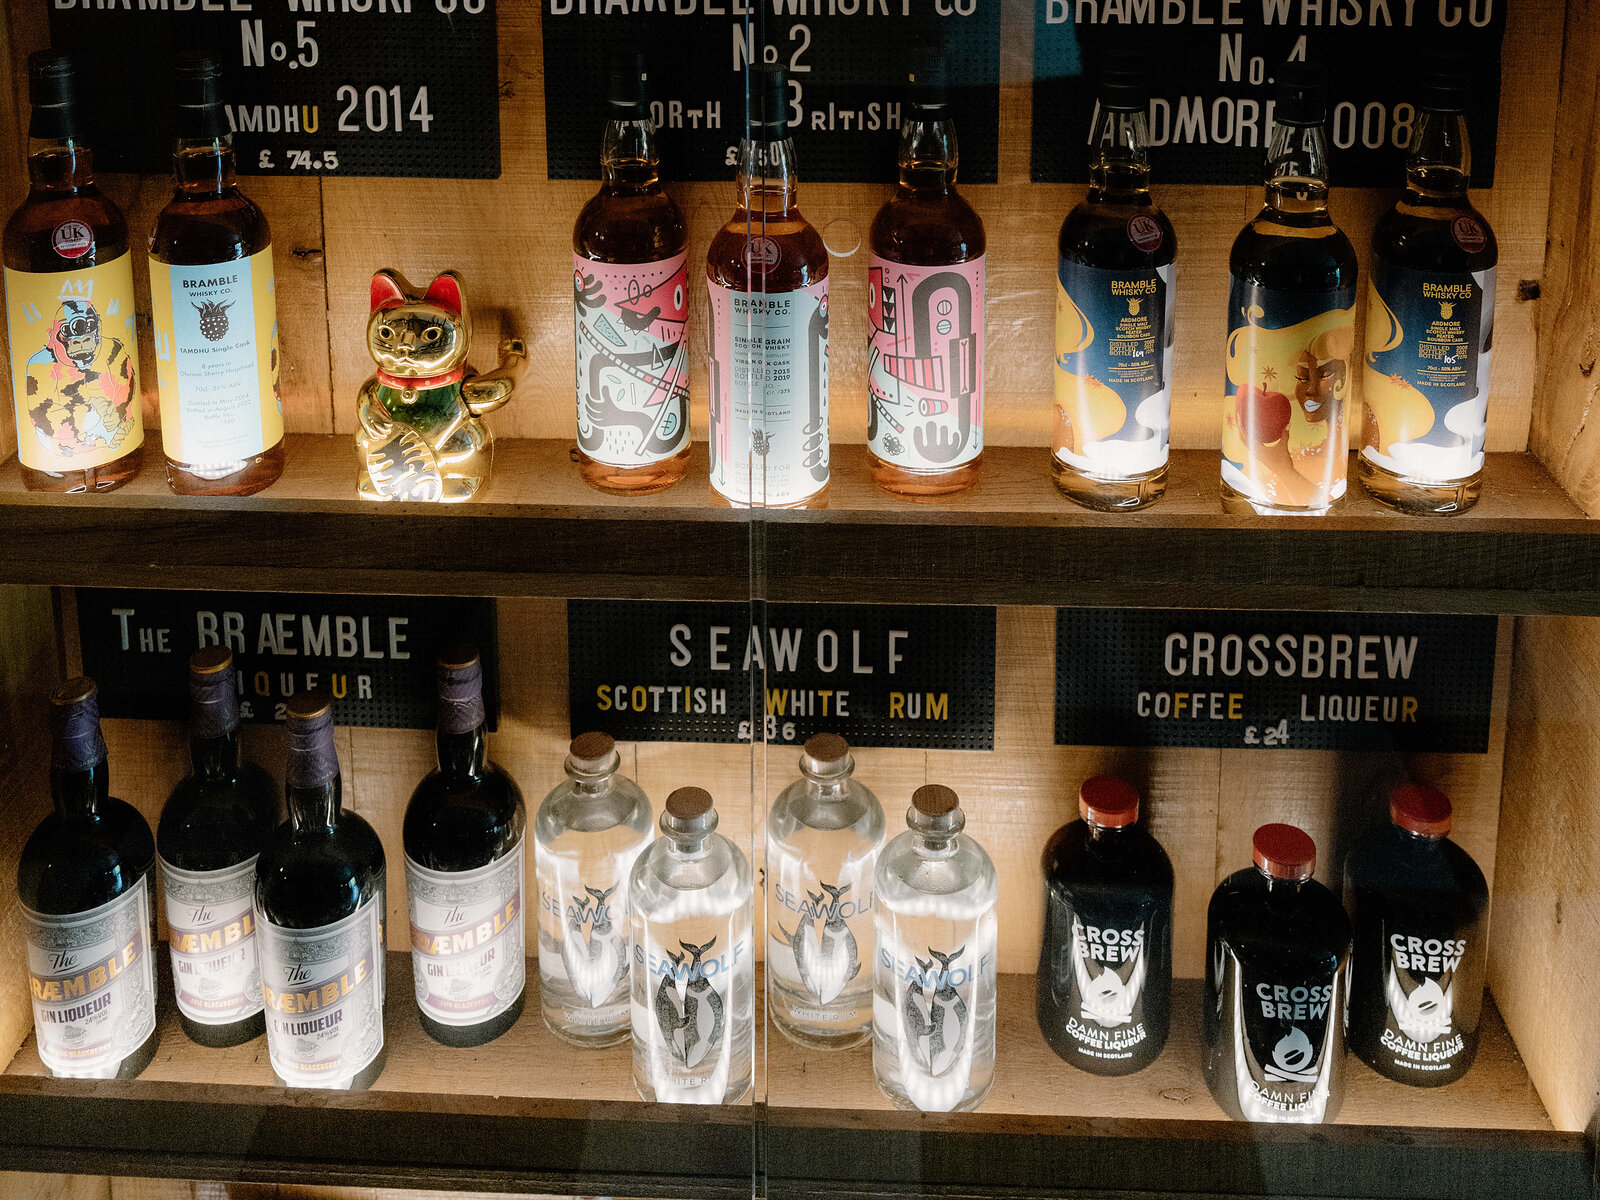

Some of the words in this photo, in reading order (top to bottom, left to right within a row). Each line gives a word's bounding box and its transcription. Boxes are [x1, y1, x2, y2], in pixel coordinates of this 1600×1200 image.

[337, 85, 434, 133] 2014
[61, 226, 84, 239] UK
[183, 274, 238, 290] BRAMBLE
[189, 288, 218, 297] WHISKY
[1111, 279, 1156, 290] BRAMBLE
[1111, 287, 1144, 296] WHISKY
[1145, 286, 1156, 294] CO
[1423, 282, 1472, 293] BRAMBLE
[1423, 290, 1458, 300] WHISKY
[1459, 290, 1472, 299] CO
[180, 347, 209, 355] TAMDHU
[211, 344, 233, 355] Single
[112, 608, 171, 653] THE
[670, 624, 908, 674] SEAWOLF
[1165, 632, 1418, 679] CROSSBREW
[597, 684, 726, 715] SCOTTISH
[766, 688, 849, 717] WHITE
[889, 691, 948, 720] RUM
[1137, 691, 1243, 720] COFFEE
[1301, 694, 1417, 723] LIQUEUR
[1071, 923, 1145, 946] CROSS
[1390, 933, 1467, 957] CROSS
[50, 950, 80, 972] The
[635, 941, 744, 981] SEAWOLF
[1078, 942, 1140, 963] BREW
[1394, 952, 1461, 973] BREW
[283, 964, 313, 983] The
[881, 947, 989, 988] SEAWOLF
[1256, 982, 1333, 1003] CROSS
[57, 992, 112, 1024] LIQUEUR
[1261, 1001, 1329, 1020] BREW
[290, 1009, 343, 1036] LIQUEUR
[1068, 1016, 1109, 1041] DAMN
[1114, 1022, 1145, 1041] FINE
[1065, 1024, 1103, 1049] COFFEE
[1104, 1030, 1147, 1050] LIQUEUR
[1383, 1028, 1428, 1052] DAMN
[1433, 1033, 1462, 1052] FINE
[1380, 1036, 1421, 1061] COFFEE
[1423, 1043, 1465, 1062] LIQUEUR
